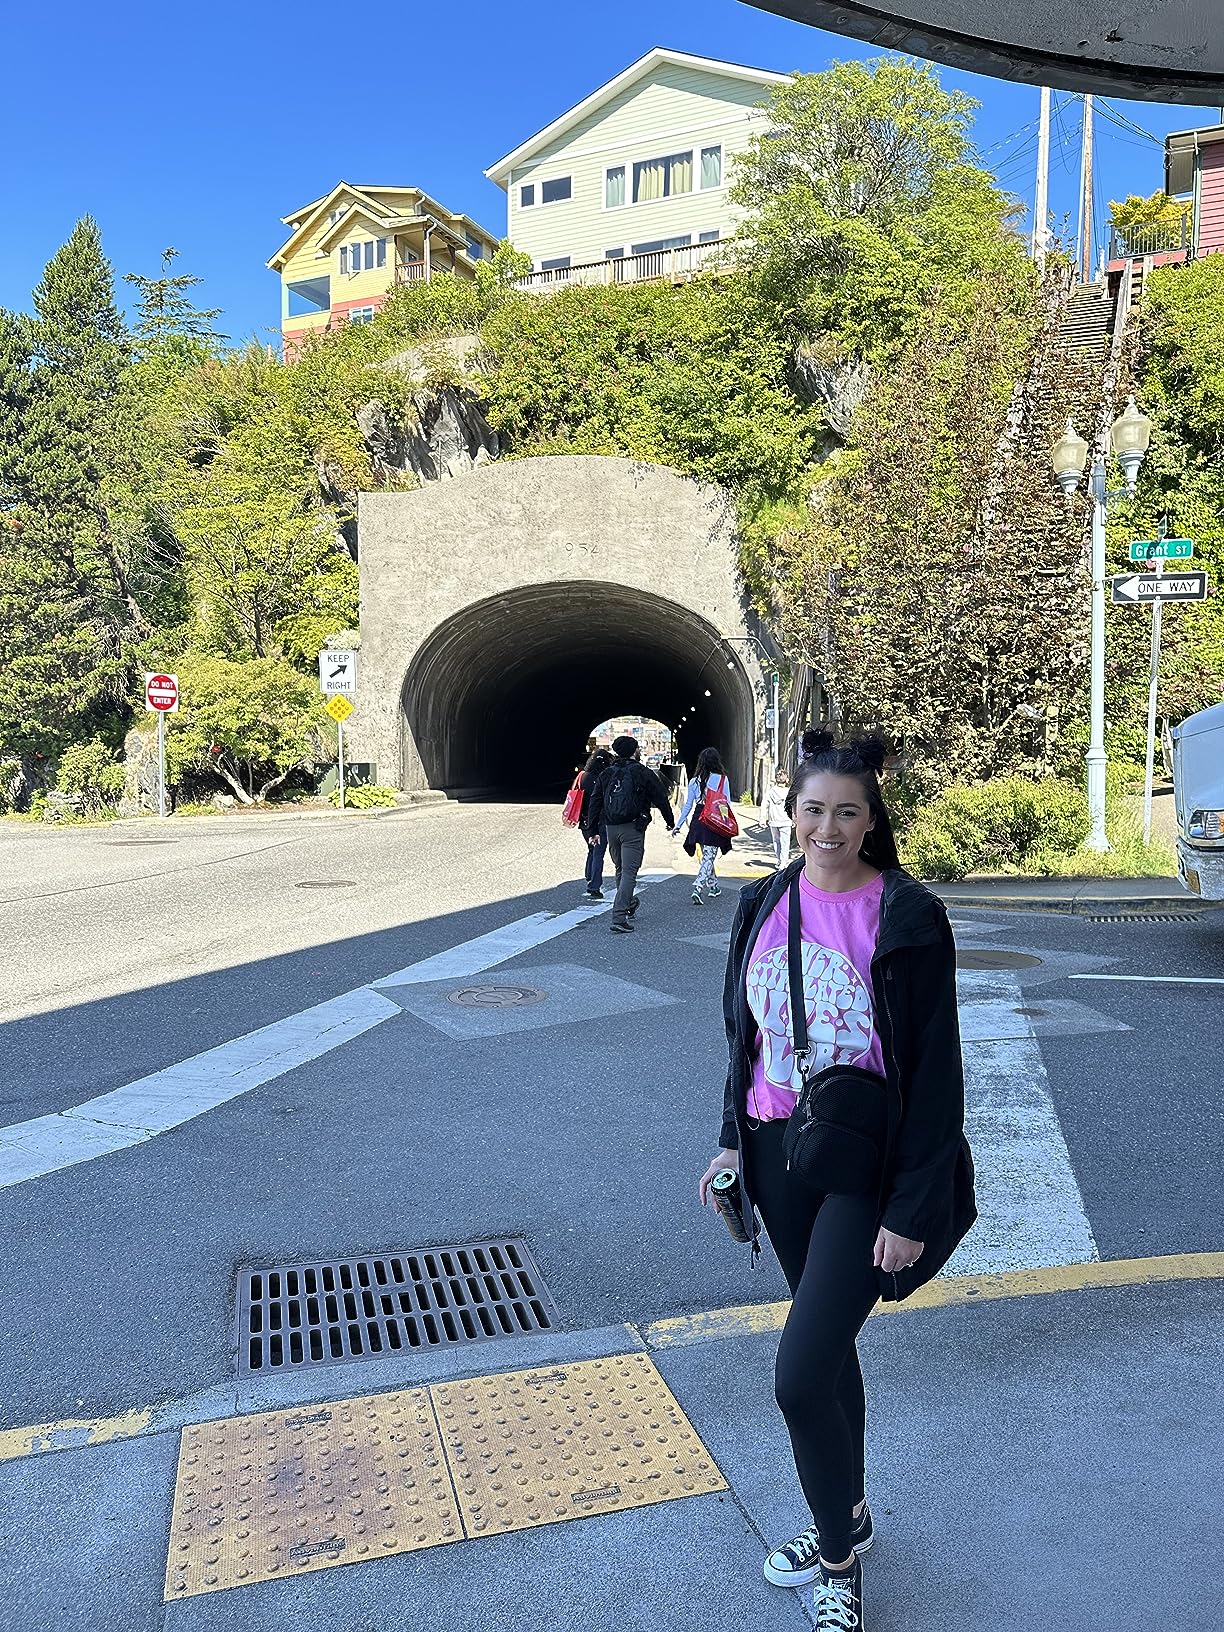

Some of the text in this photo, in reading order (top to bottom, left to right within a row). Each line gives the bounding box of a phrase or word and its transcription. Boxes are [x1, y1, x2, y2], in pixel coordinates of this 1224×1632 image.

[1135, 542, 1188, 557] Grant ST
[1138, 581, 1195, 594] ONE WAY
[327, 654, 350, 663] KEEP
[151, 680, 174, 689] DO NOT
[326, 681, 351, 690] RIGHT
[153, 696, 172, 705] ENTER
